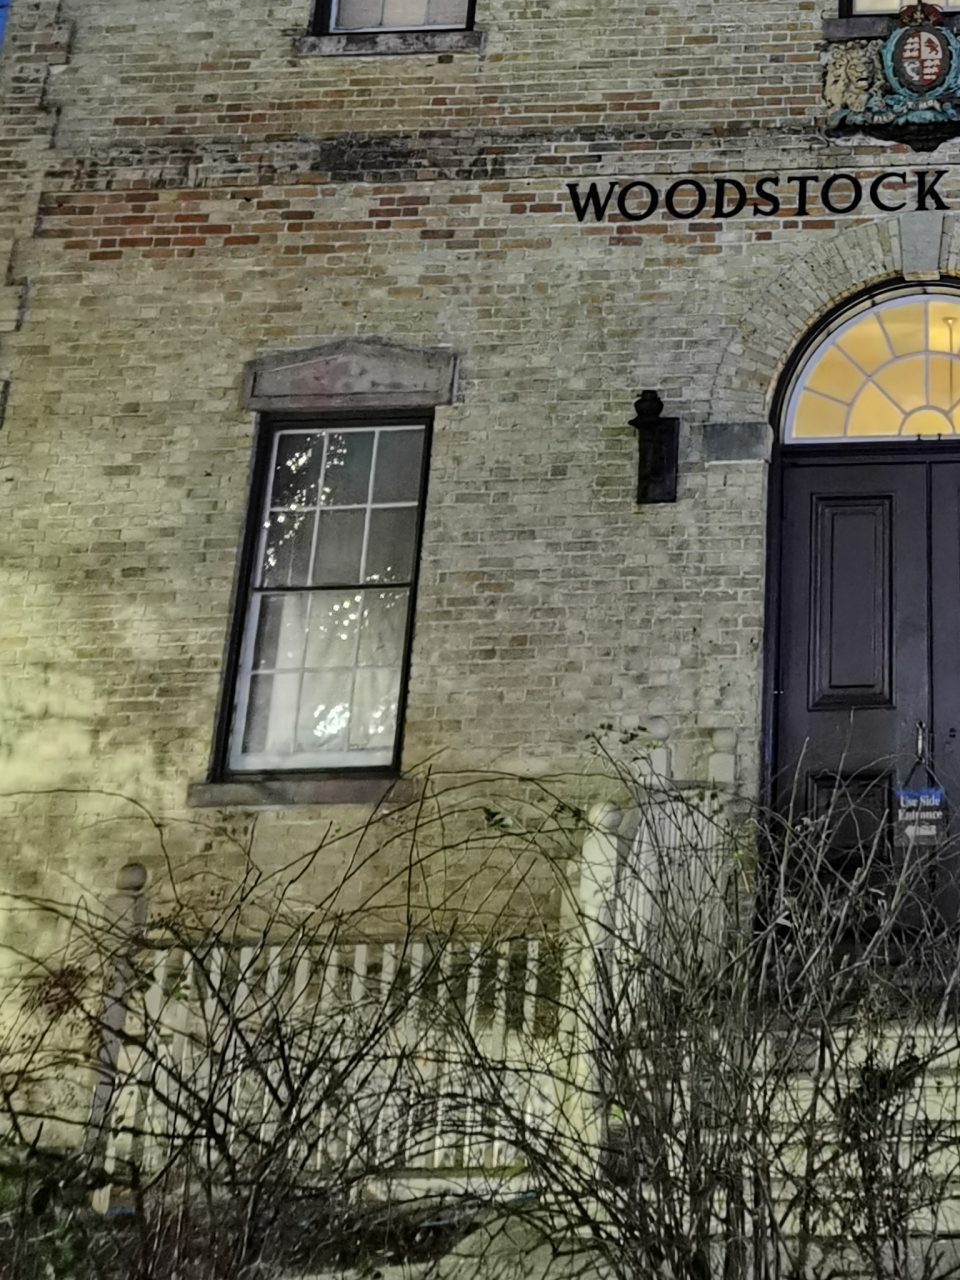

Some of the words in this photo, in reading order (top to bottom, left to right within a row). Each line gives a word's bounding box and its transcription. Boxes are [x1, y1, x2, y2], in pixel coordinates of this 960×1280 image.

[565, 169, 951, 222] WOODSTOCK
[900, 795, 918, 808] Use
[920, 794, 940, 807] Side
